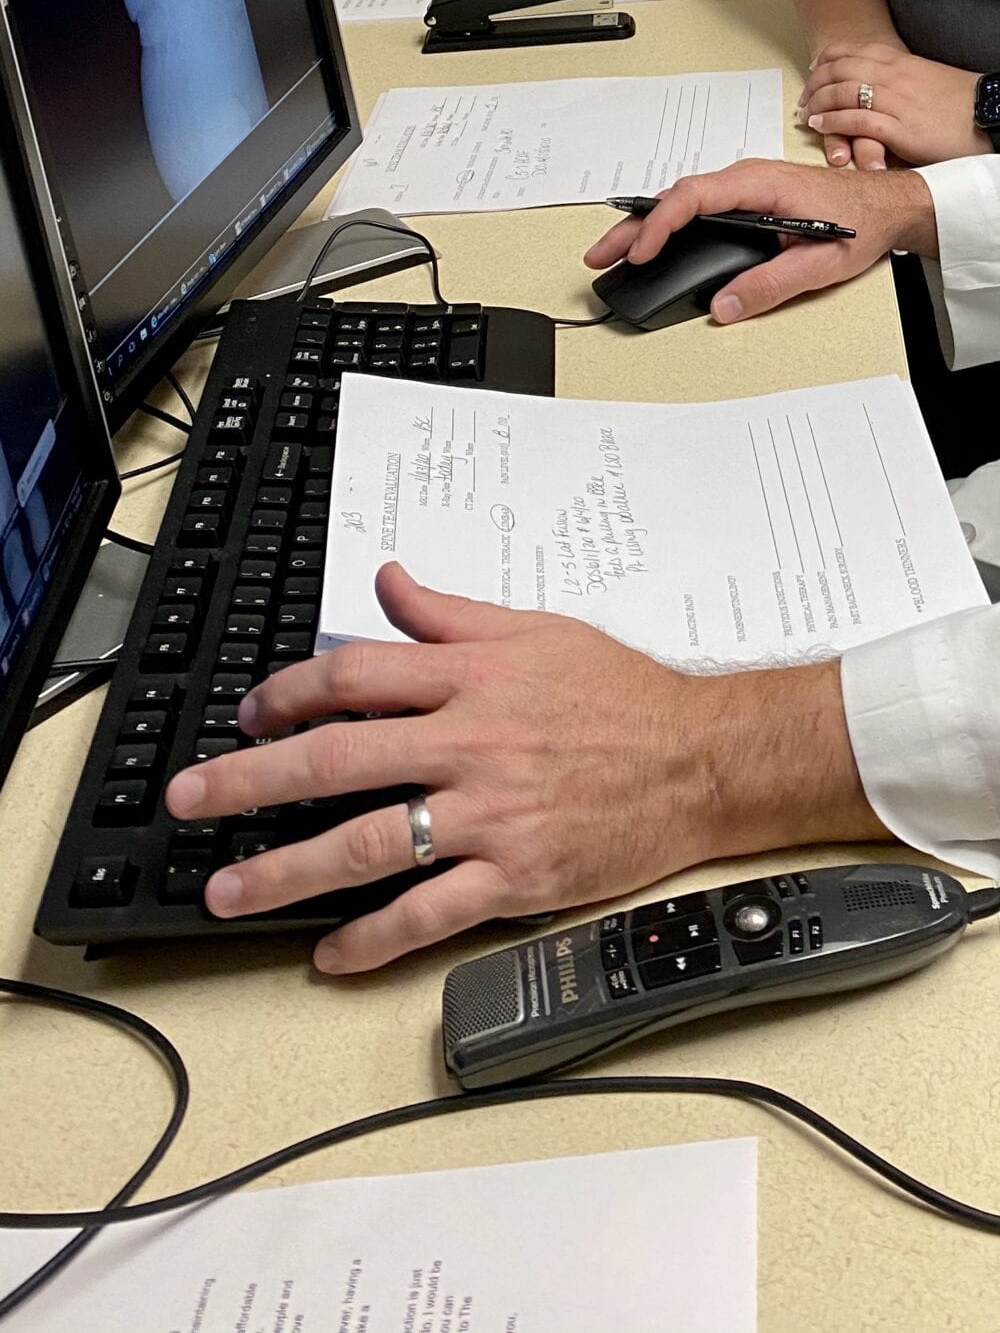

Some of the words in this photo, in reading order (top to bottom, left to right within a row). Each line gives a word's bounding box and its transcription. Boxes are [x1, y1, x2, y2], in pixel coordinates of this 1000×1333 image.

[276, 445, 290, 470] Backspace
[383, 451, 400, 502] EVALUATION
[381, 502, 397, 526] TEAM
[380, 528, 395, 552] SPINE
[500, 535, 511, 565] THORACIC
[895, 538, 916, 577] THINNERS
[501, 568, 511, 597] CERVICAL
[772, 571, 786, 605] INJECTIONS
[796, 574, 809, 603] THERAPY
[817, 571, 836, 613] MANAGEMENT
[685, 612, 699, 646] RADIATING
[778, 606, 793, 637] PREVIOUS
[802, 604, 816, 633] PHYSICAL
[827, 614, 839, 630] PAIN
[850, 610, 861, 626] PAST
[791, 930, 800, 938] F1
[811, 925, 820, 935] F2
[555, 936, 579, 1004] PHILIPS
[408, 1269, 423, 1288] just
[430, 1260, 442, 1273] be
[281, 1280, 293, 1299] and
[341, 1268, 362, 1304] having
[406, 1291, 419, 1301] is
[424, 1276, 439, 1309] would
[443, 1295, 454, 1316] can
[458, 1296, 473, 1318] The
[456, 1321, 468, 1333] to
